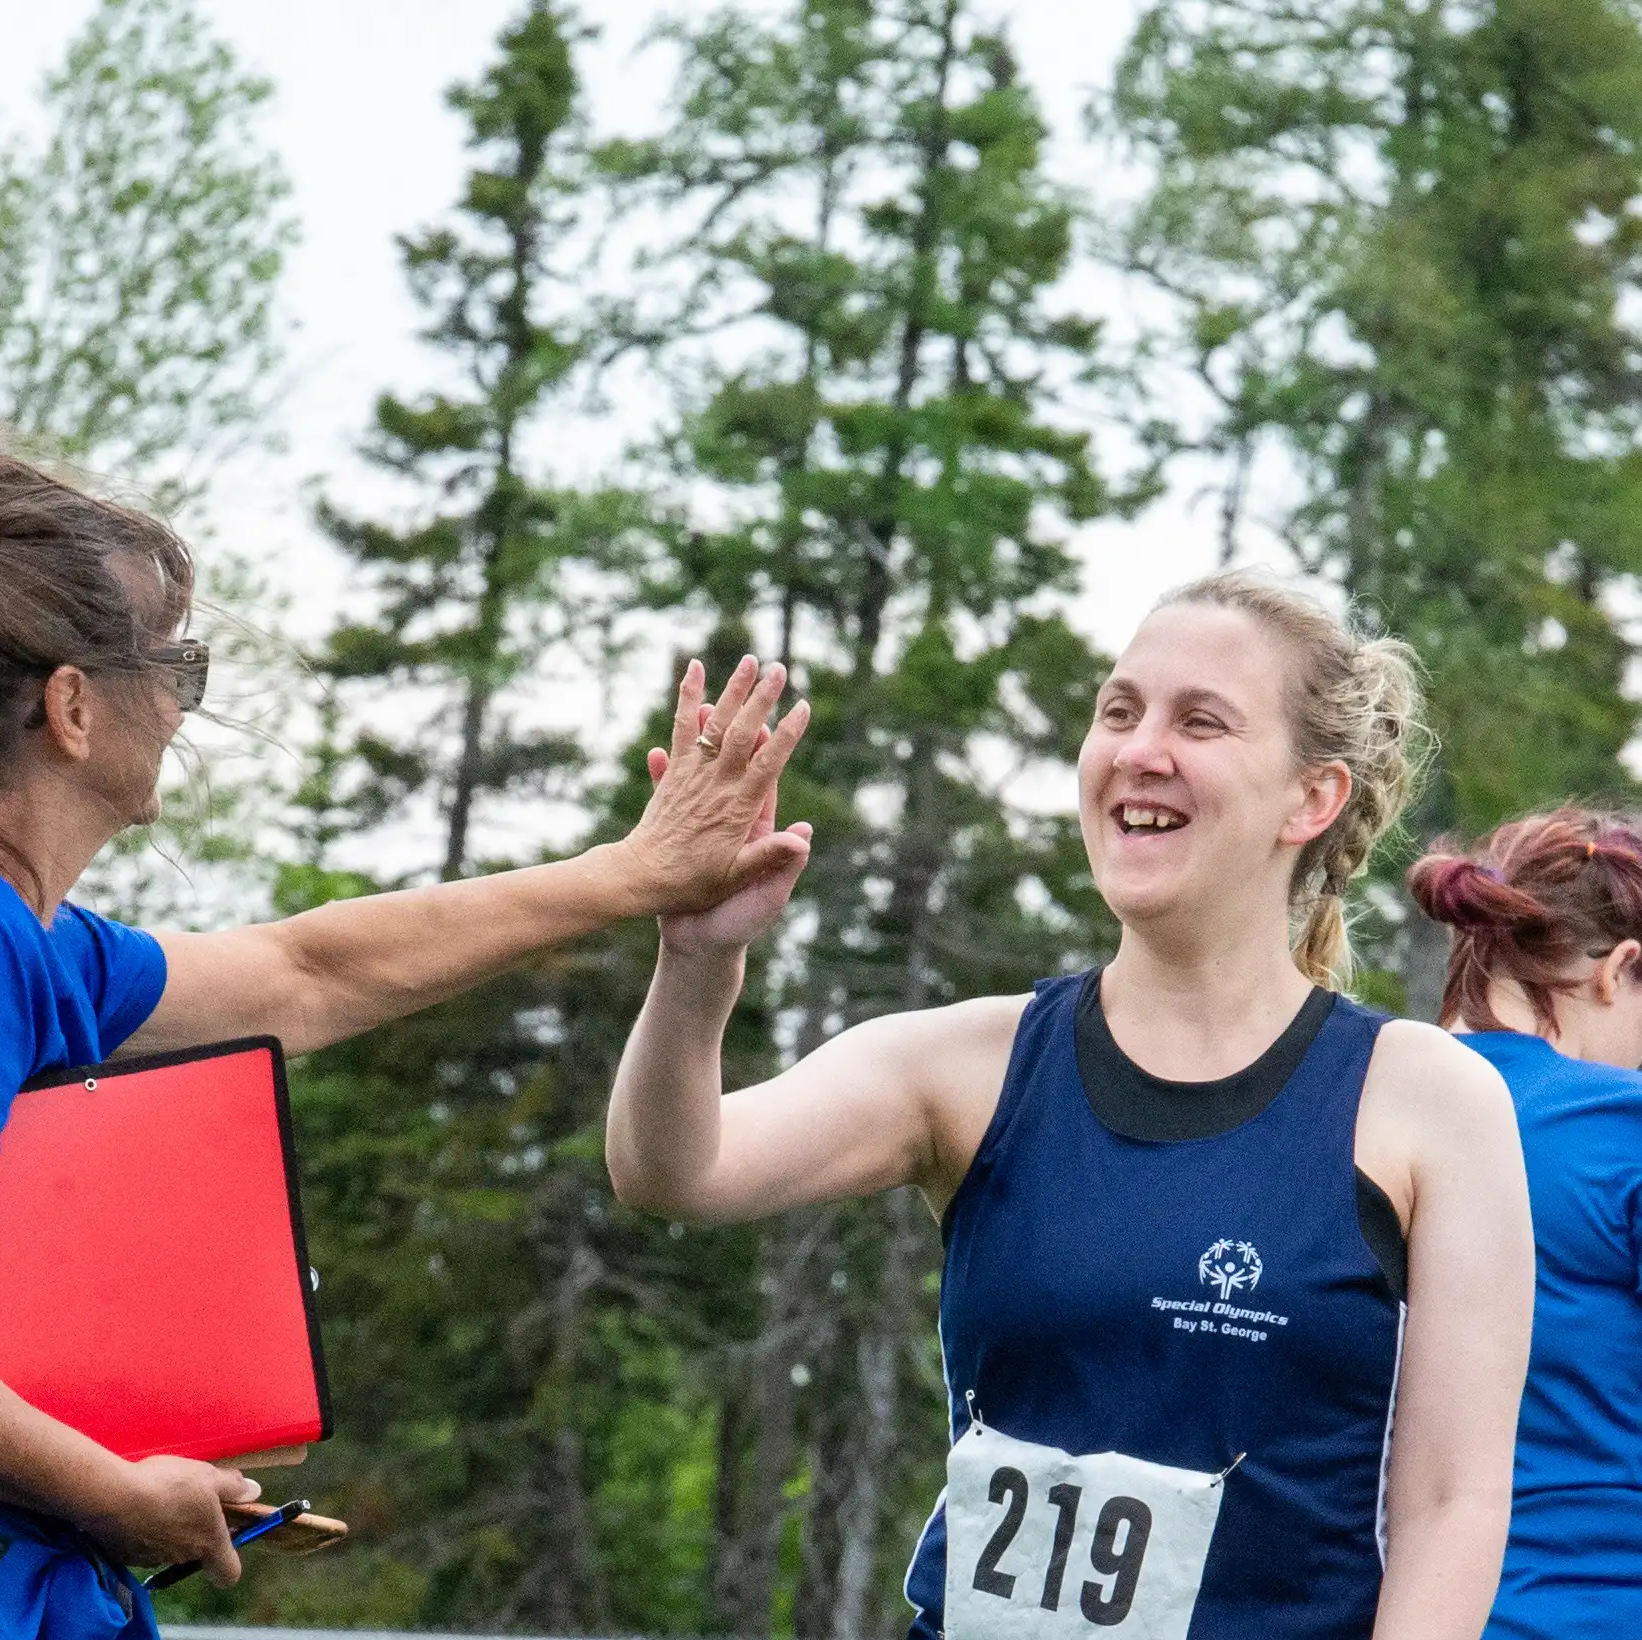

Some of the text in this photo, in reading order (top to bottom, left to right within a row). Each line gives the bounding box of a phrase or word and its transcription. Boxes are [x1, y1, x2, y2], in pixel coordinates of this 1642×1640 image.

[1151, 1296, 1289, 1325] Special Olympics
[1173, 1317, 1268, 1342] Bay St. George
[972, 1466, 1152, 1627] 219
